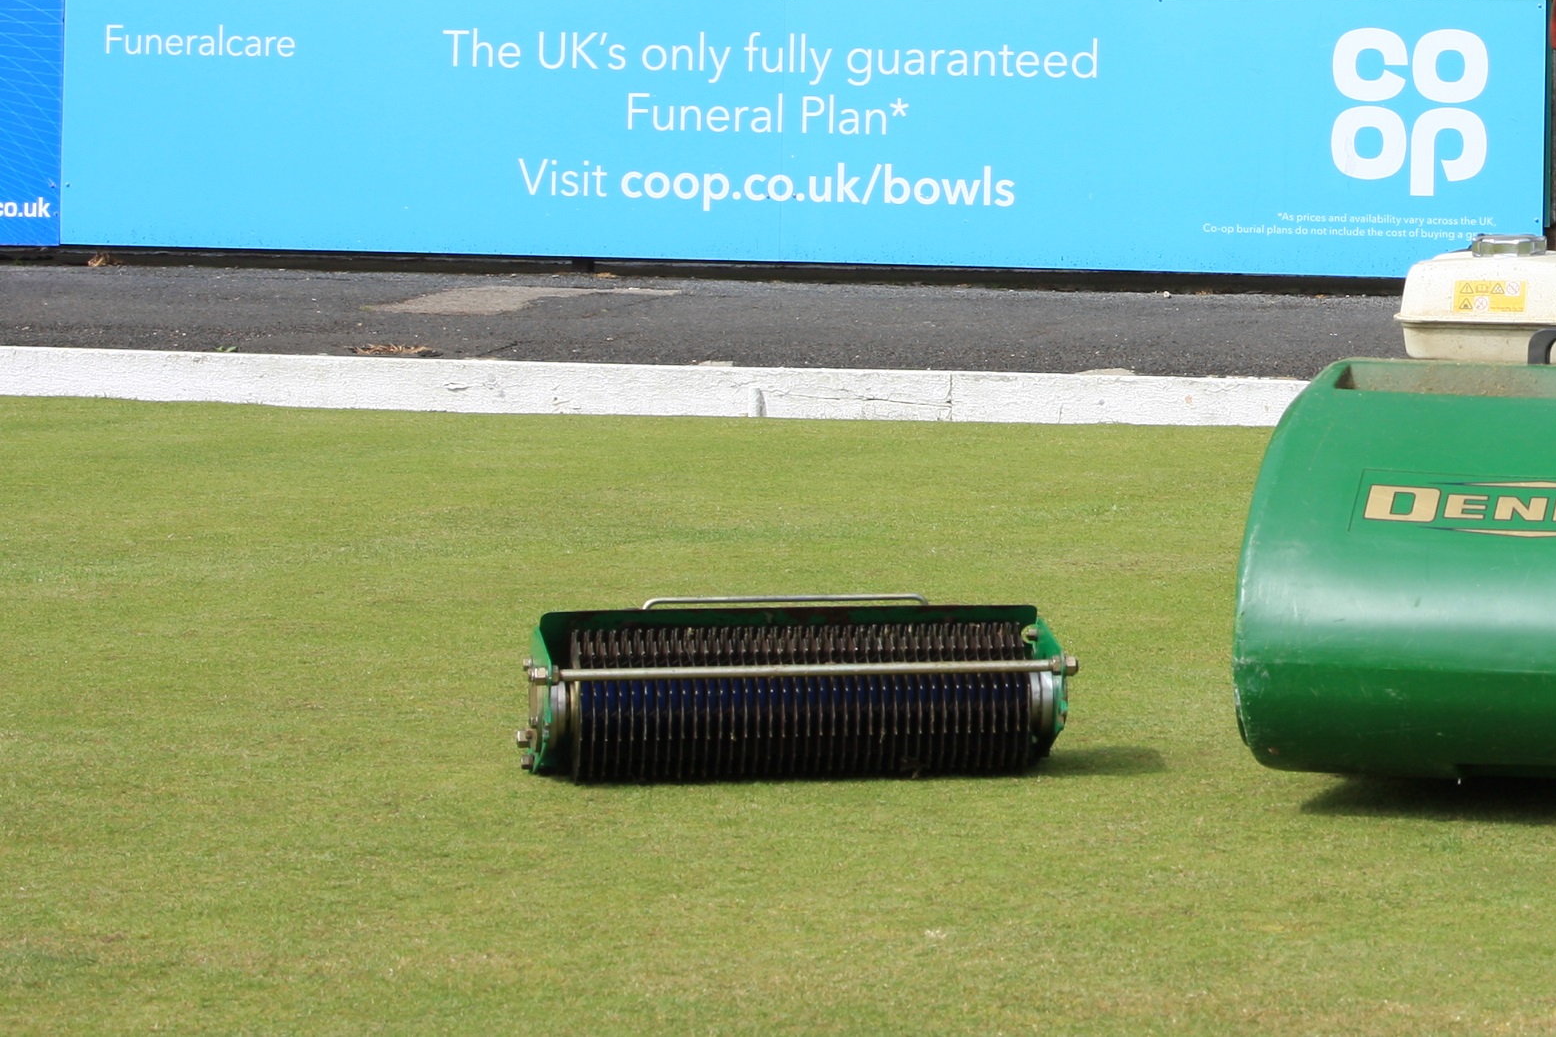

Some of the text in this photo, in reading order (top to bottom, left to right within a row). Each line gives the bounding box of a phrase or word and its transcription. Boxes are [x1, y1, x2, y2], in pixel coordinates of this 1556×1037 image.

[105, 24, 296, 58] Funeralcare
[443, 28, 521, 69] The
[641, 32, 731, 83] only
[744, 32, 833, 85] fully
[847, 38, 1099, 87] guaranteed
[626, 93, 783, 133] Funeral
[518, 158, 1015, 211] Visit coop.co.uk/bowls
[1203, 223, 1234, 235] Co-op
[1236, 224, 1265, 234] burial
[1266, 224, 1293, 236] plans
[1295, 224, 1309, 235] do
[1310, 226, 1327, 235] not
[1329, 225, 1366, 236] include
[1367, 226, 1384, 237] the
[1385, 227, 1407, 238] cost
[1408, 227, 1419, 238] of
[1420, 228, 1455, 241] buying
[1296, 213, 1326, 224] prices
[1328, 213, 1347, 223] and
[1349, 214, 1401, 226] availability
[1403, 217, 1424, 227] vary
[1426, 217, 1458, 226] across
[1460, 216, 1477, 226] the
